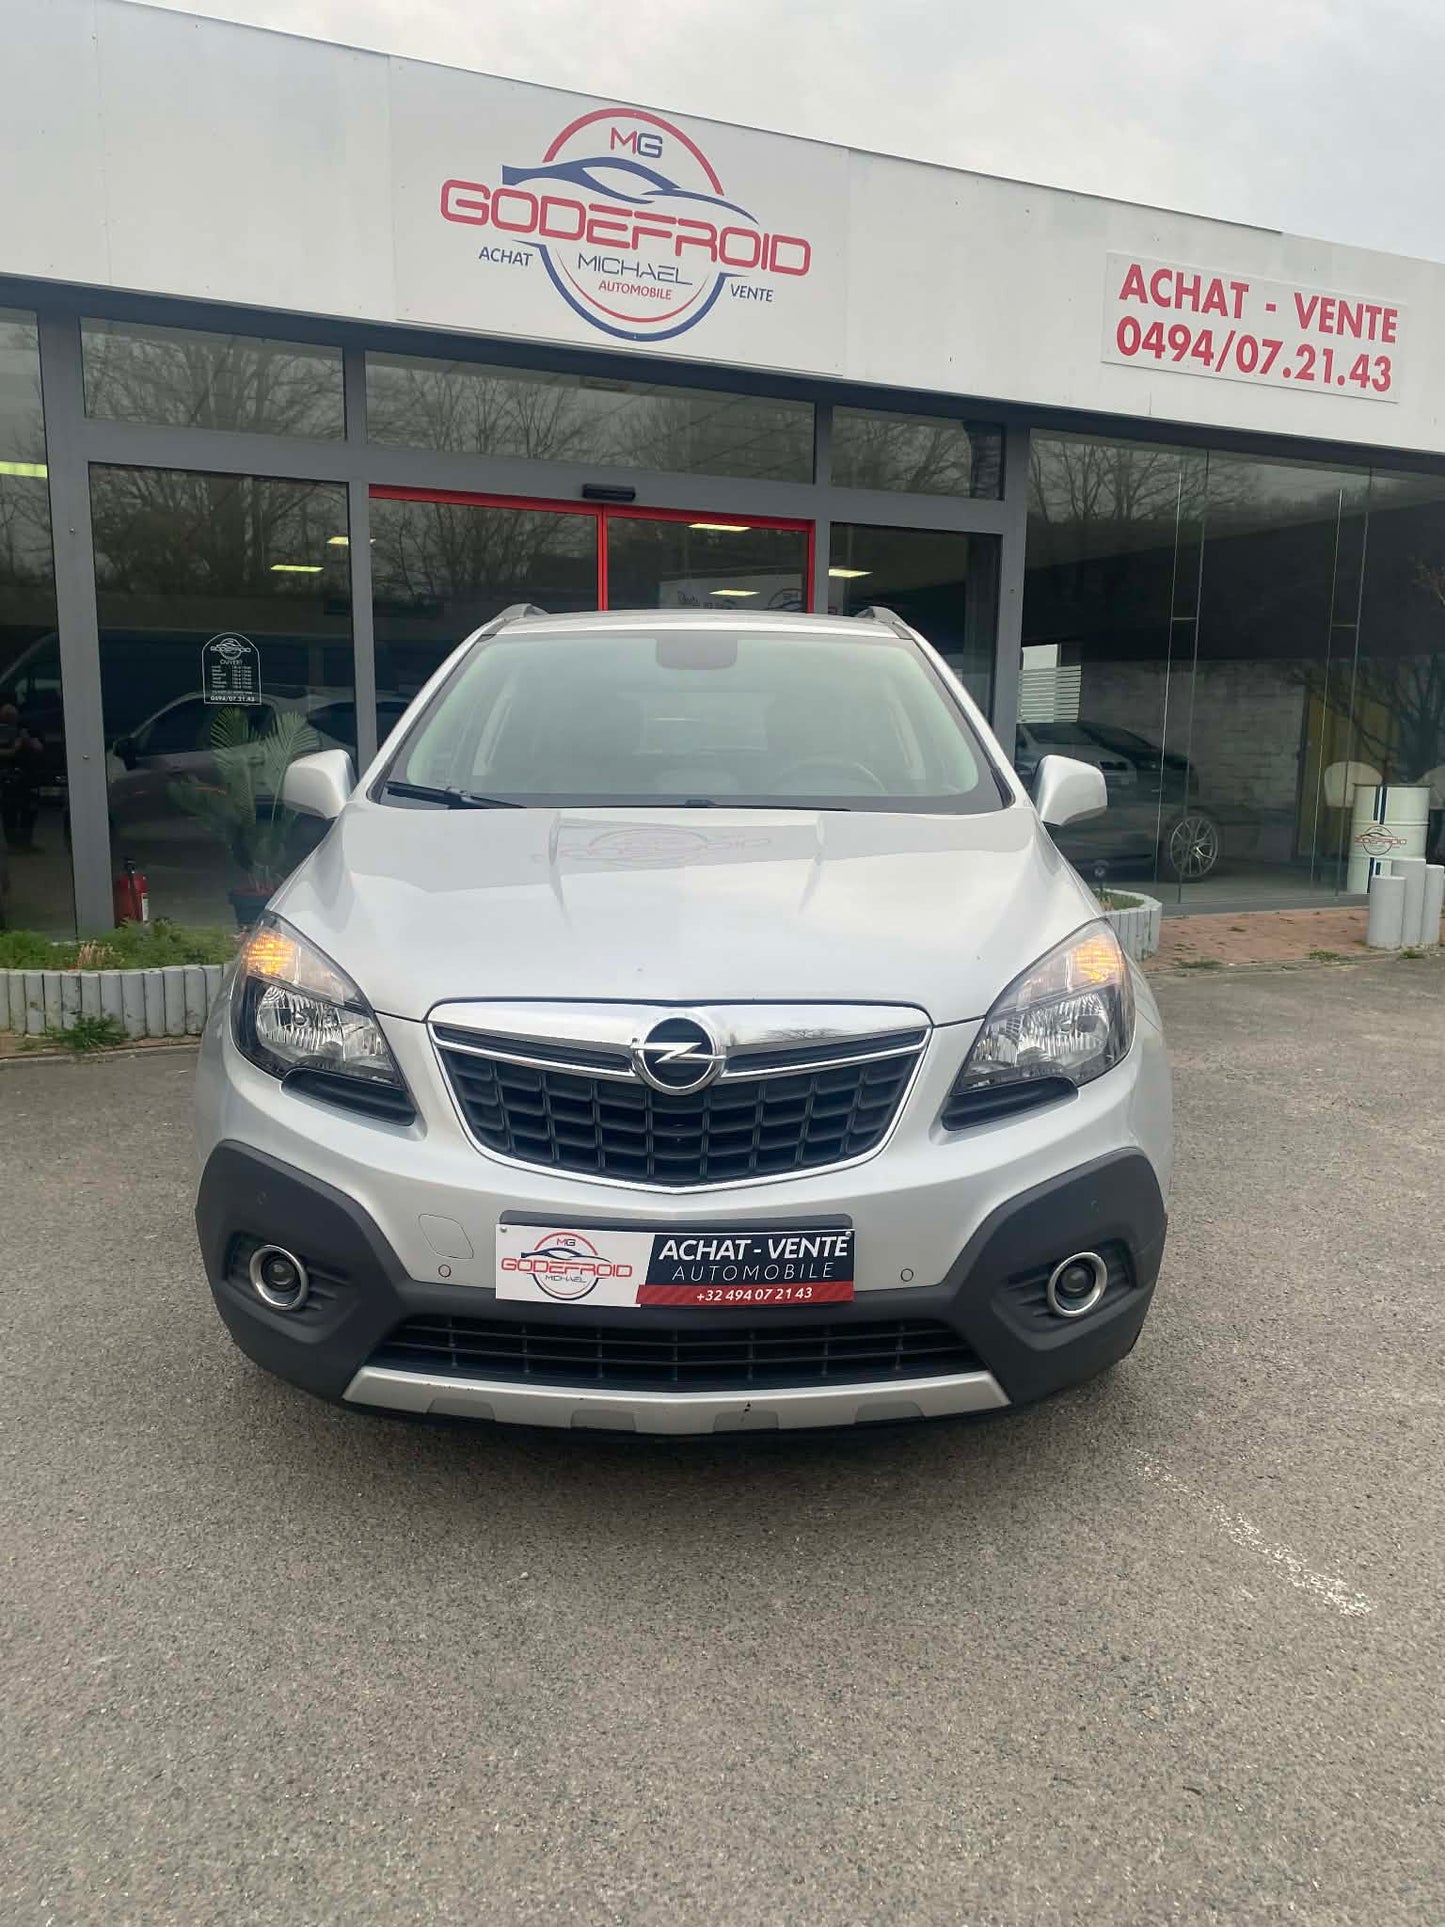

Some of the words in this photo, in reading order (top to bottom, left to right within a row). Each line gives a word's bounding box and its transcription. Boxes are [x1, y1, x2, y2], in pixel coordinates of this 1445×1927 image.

[611, 127, 663, 158] MG
[440, 179, 812, 277] GODEFROID
[479, 246, 533, 267] ACHAT
[578, 253, 693, 286] MICHAEL
[598, 280, 672, 300] AUTOMOBILE
[730, 284, 774, 303] VENTE
[1119, 264, 1249, 319] ACHAT
[1265, 303, 1277, 312] -
[1294, 292, 1398, 343] VENTE
[1117, 316, 1391, 392] 0494/07.21.43
[557, 1238, 576, 1247] MG
[659, 1239, 751, 1260] ACHAT
[768, 1236, 850, 1259] VENTE
[501, 1257, 633, 1278] GODEFROID
[672, 1262, 835, 1282] AUTOMOBILE
[696, 1289, 722, 1301] +32
[725, 1288, 751, 1301] 494
[755, 1288, 772, 1300] 07
[774, 1287, 792, 1300] 21
[795, 1286, 813, 1299] 43
